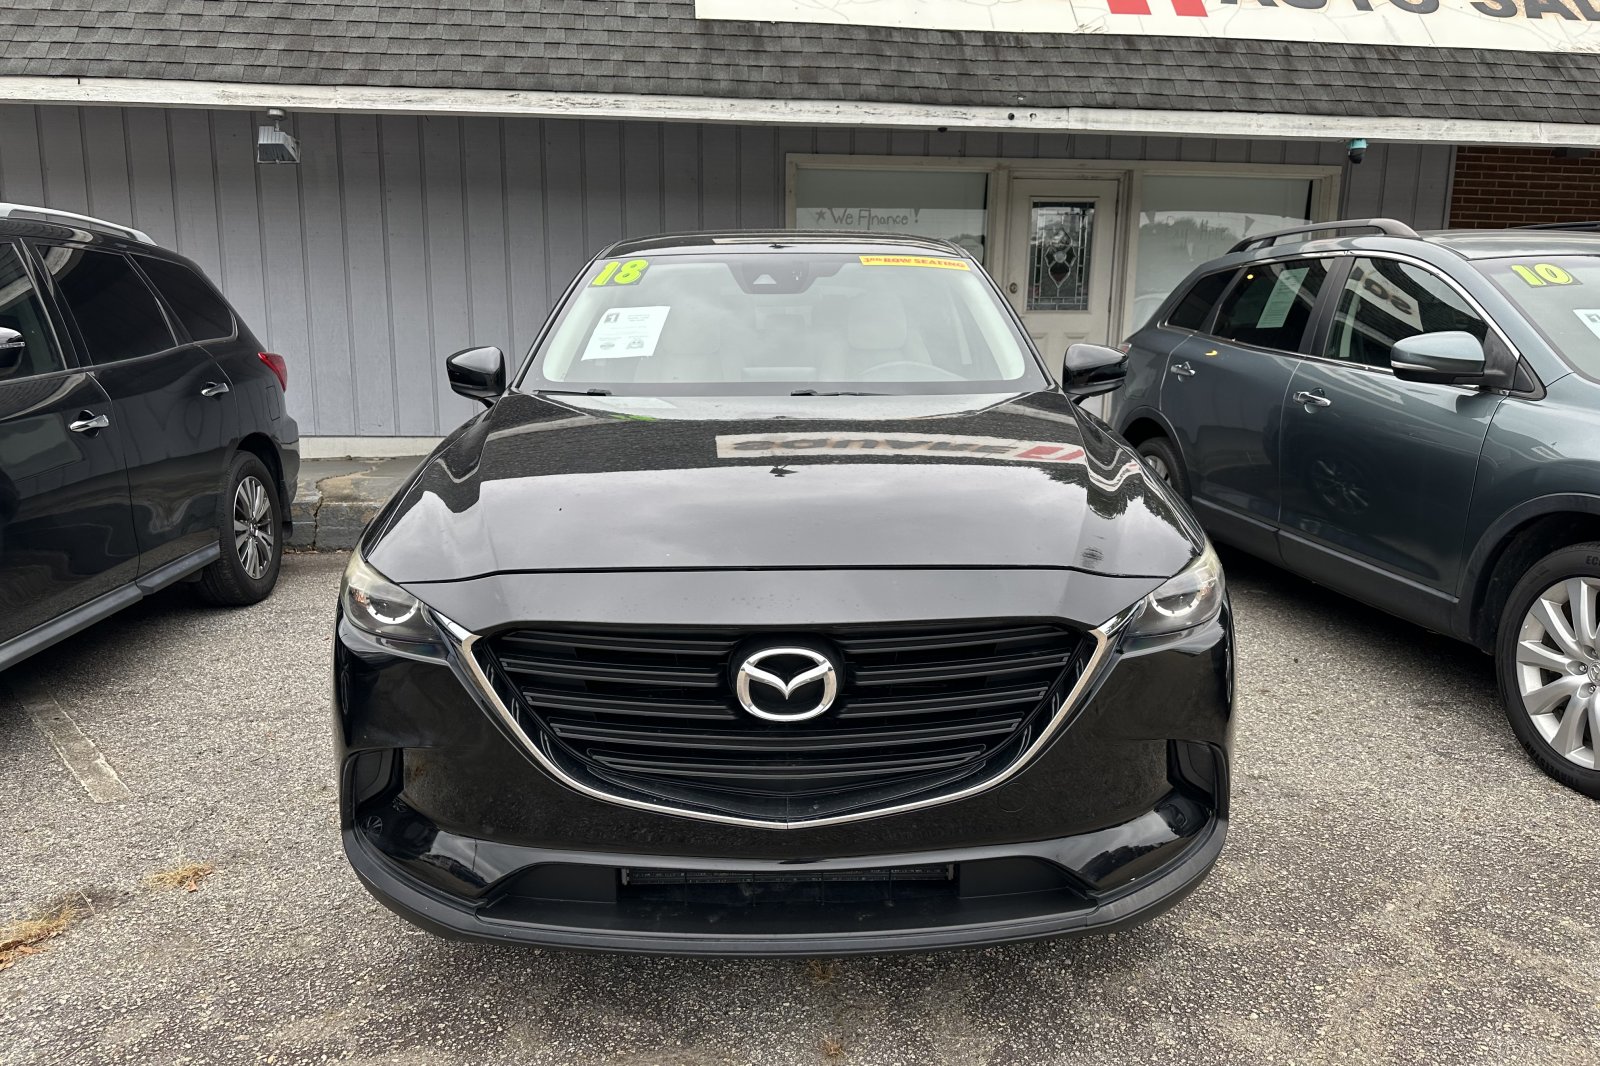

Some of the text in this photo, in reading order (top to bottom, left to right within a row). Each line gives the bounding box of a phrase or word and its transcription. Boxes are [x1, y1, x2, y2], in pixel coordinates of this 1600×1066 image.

[591, 259, 649, 286] 18
[914, 258, 966, 268] SEATING
[1511, 263, 1574, 286] 10
